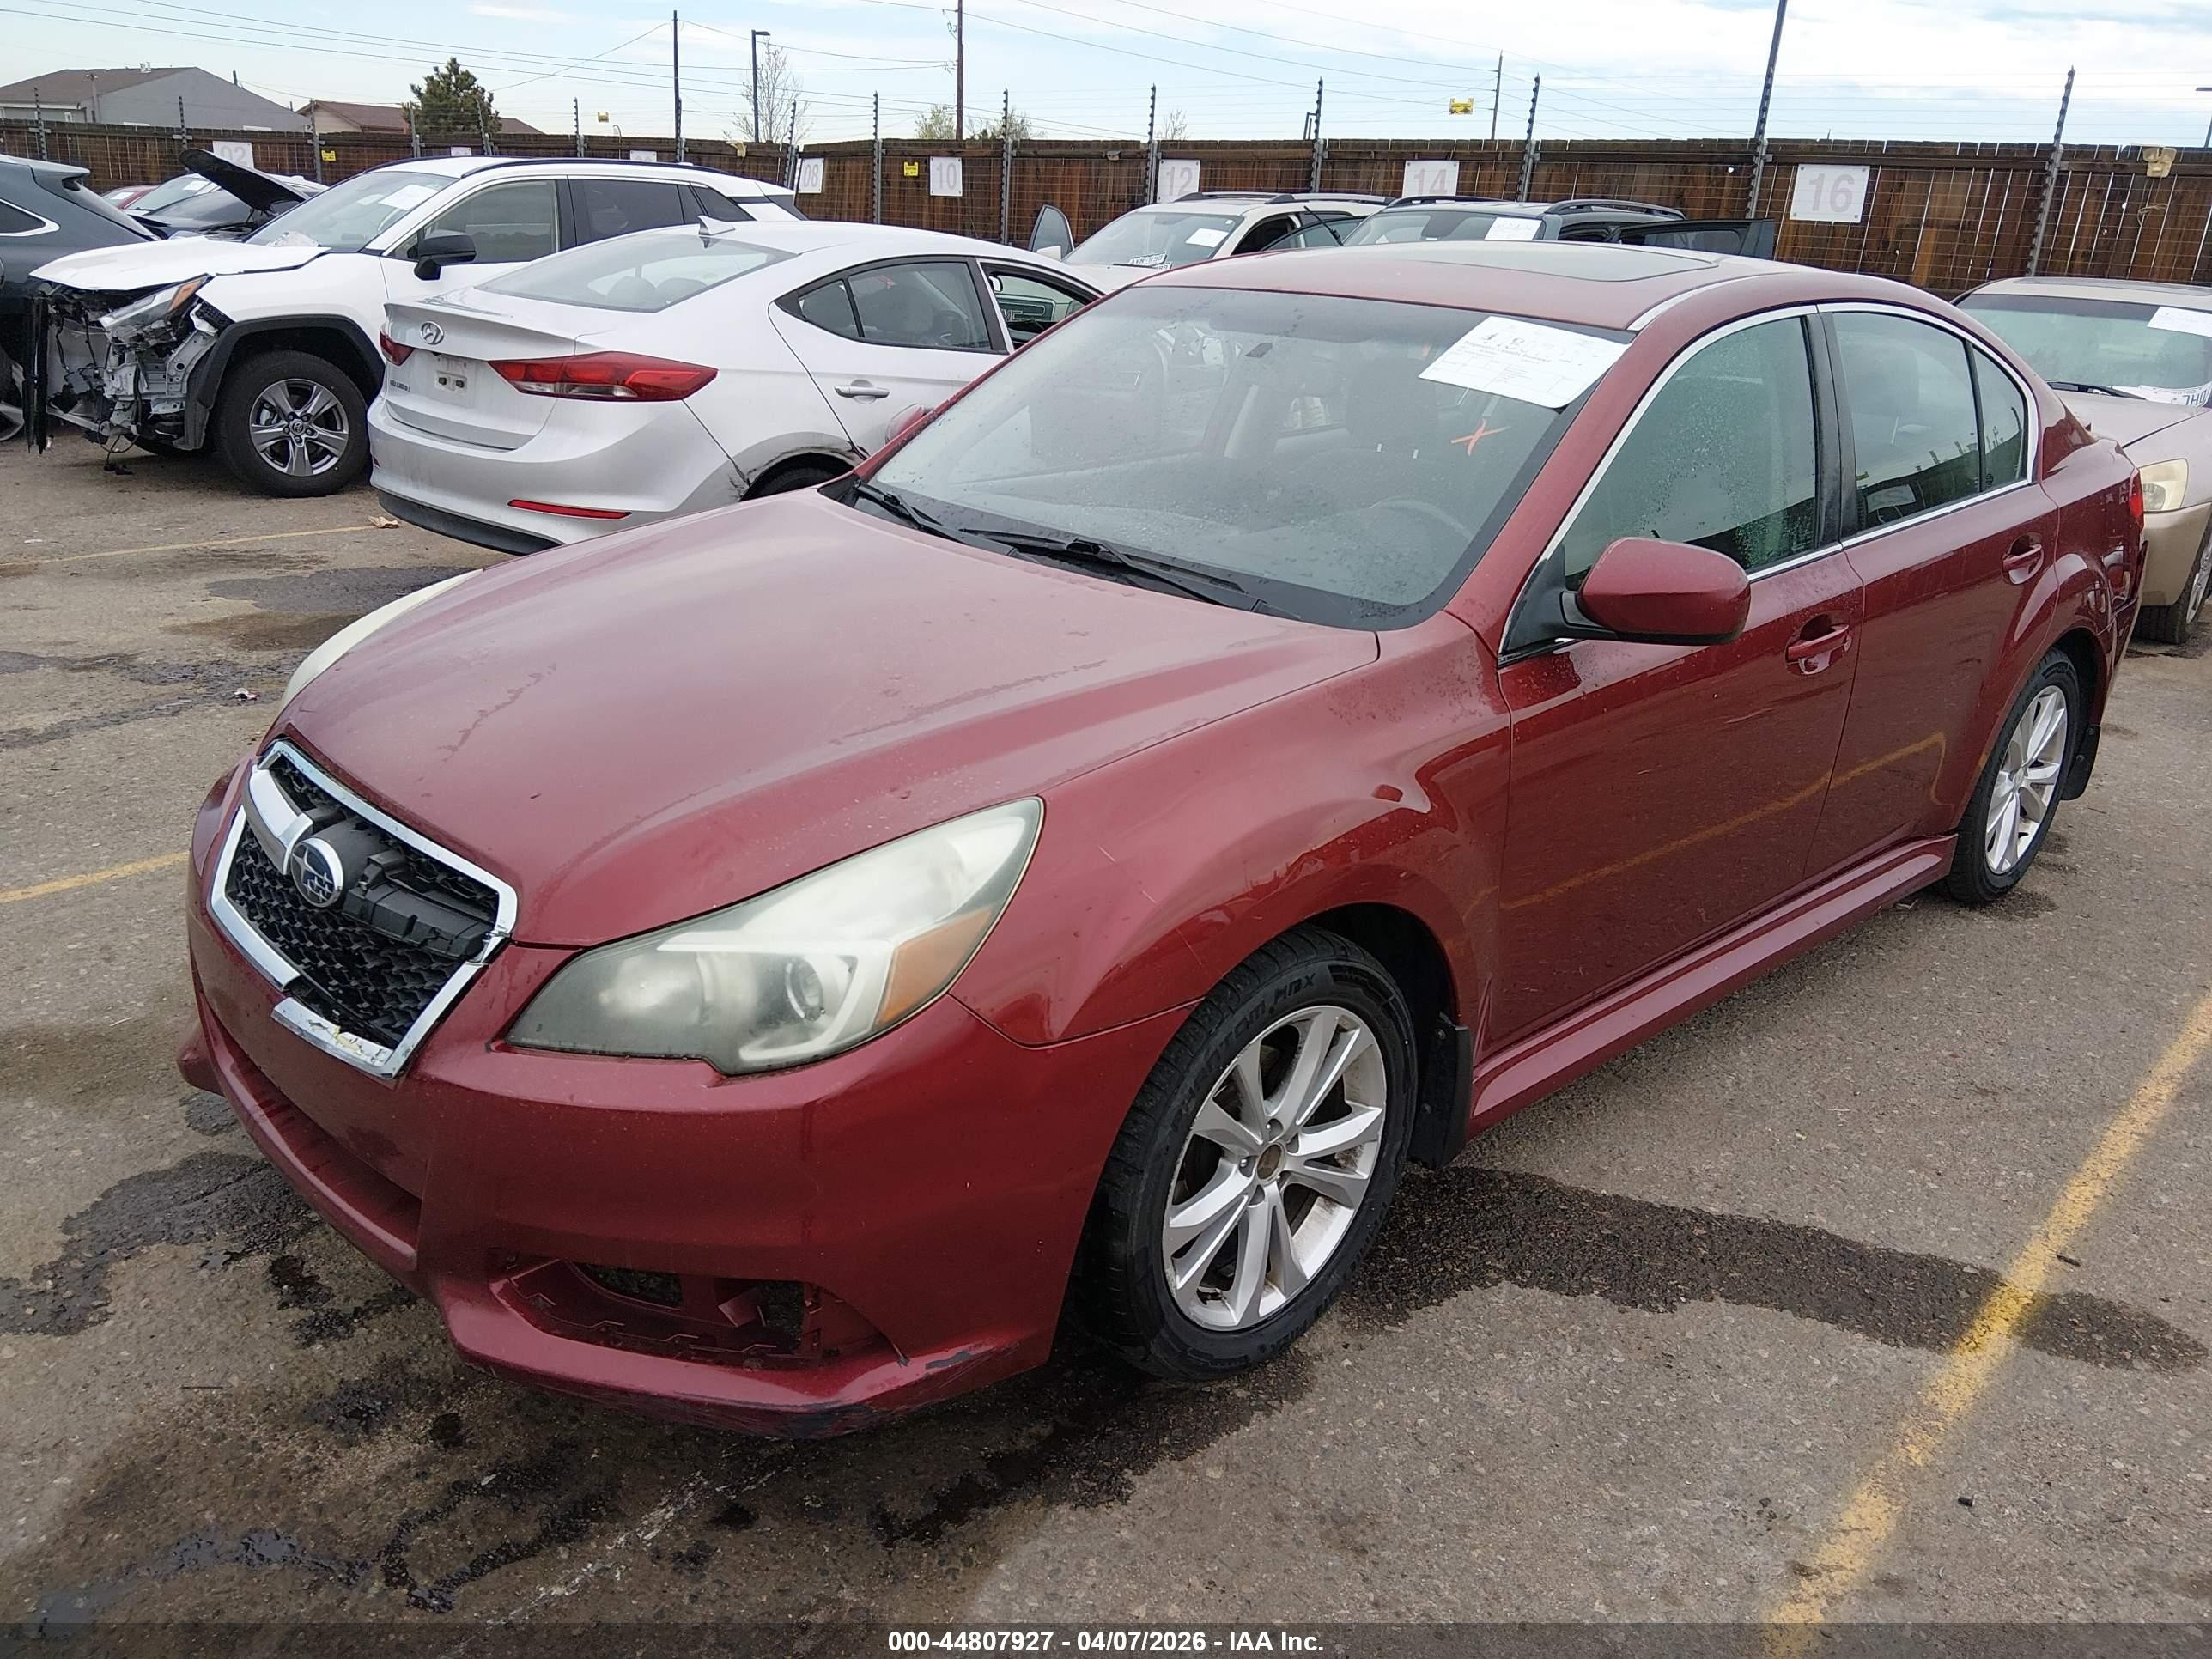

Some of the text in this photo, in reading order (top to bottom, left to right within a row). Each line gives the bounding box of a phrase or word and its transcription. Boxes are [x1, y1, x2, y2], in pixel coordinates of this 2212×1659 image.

[804, 163, 819, 188] 08
[936, 162, 957, 191] 10
[1166, 166, 1193, 197] 12
[1413, 167, 1448, 195] 14
[1808, 173, 1856, 214] 16
